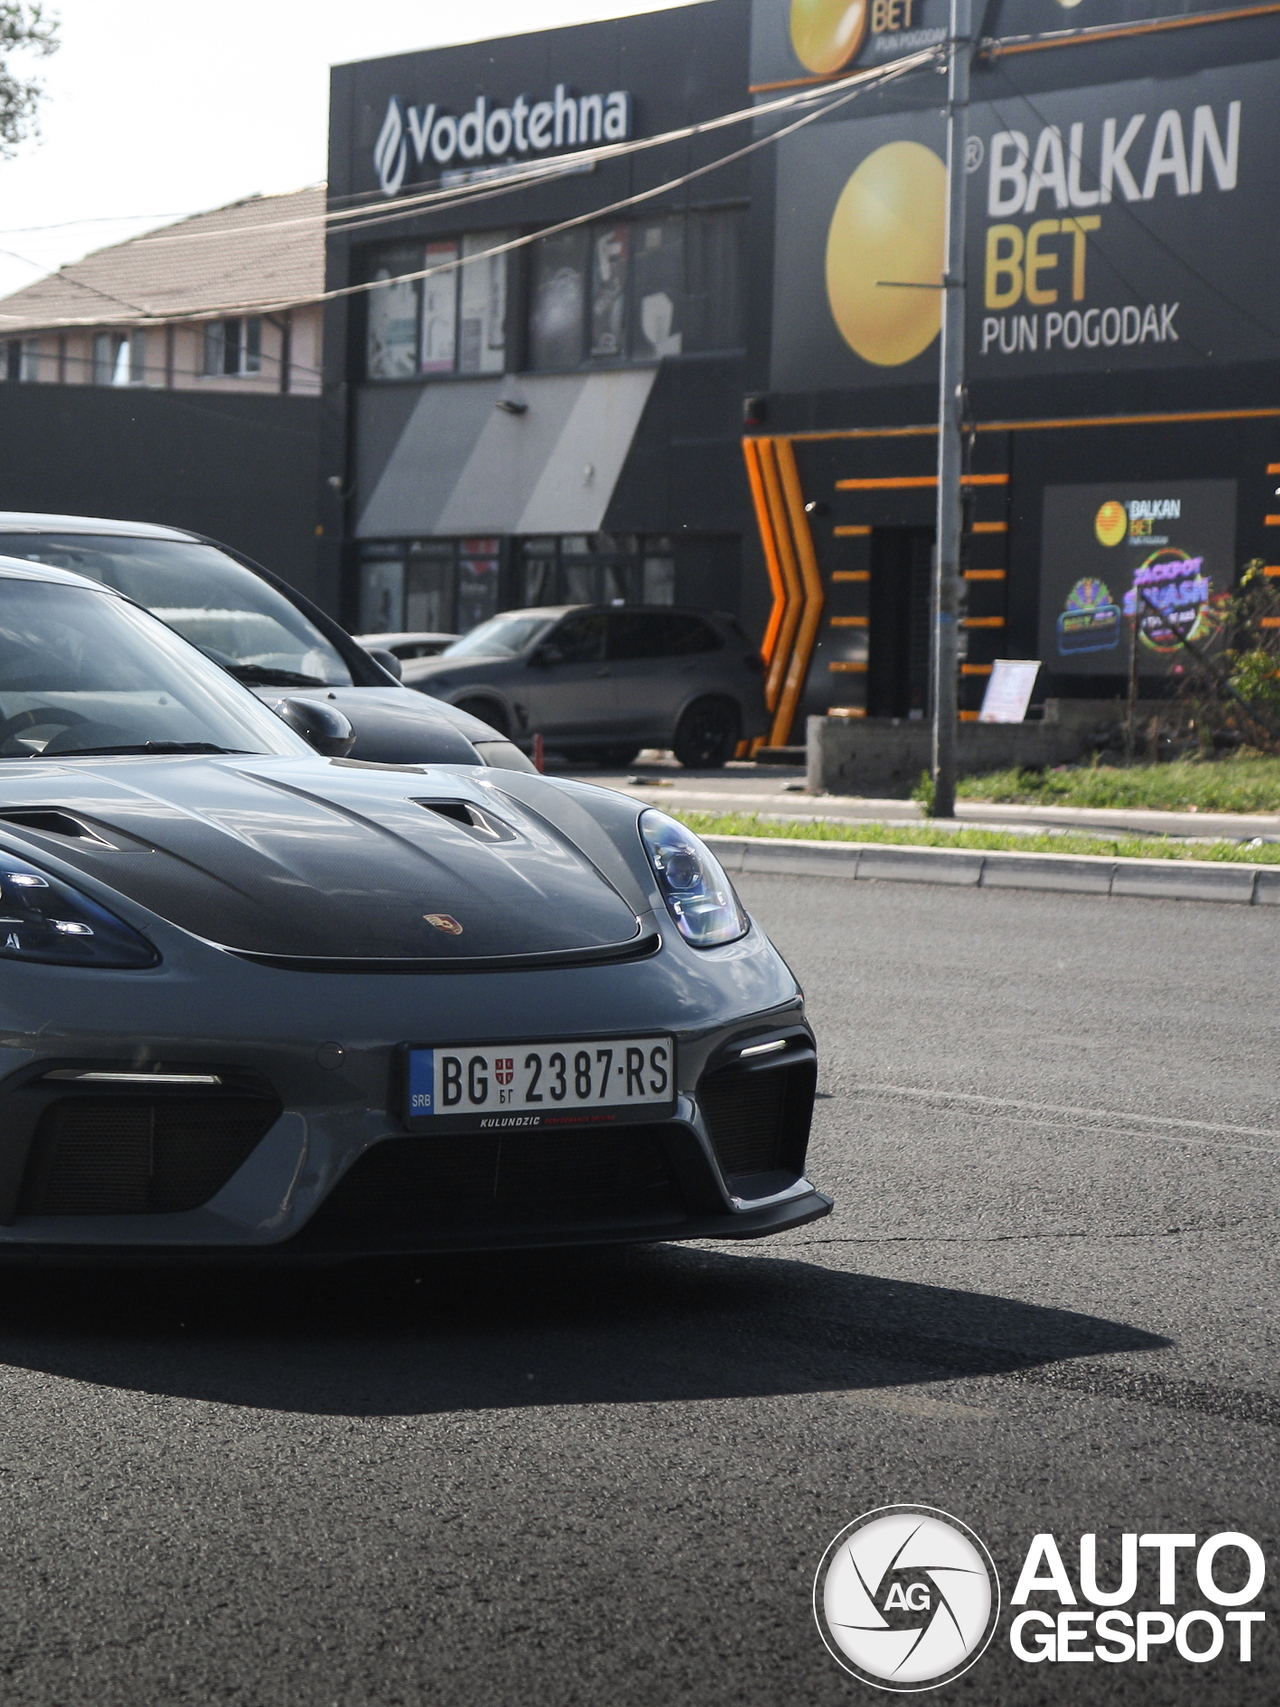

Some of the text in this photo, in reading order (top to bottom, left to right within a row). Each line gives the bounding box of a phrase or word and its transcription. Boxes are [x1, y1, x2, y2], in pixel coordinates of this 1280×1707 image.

[407, 83, 629, 164] Vodotehna
[987, 100, 1242, 218] BALKAN
[984, 214, 1102, 310] BET
[980, 301, 1180, 355] PUN POGODAK
[1129, 499, 1181, 519] BALKAN
[412, 1094, 431, 1108] SRB
[442, 1055, 489, 1107] BG
[480, 1116, 541, 1128] KULUNDZIC
